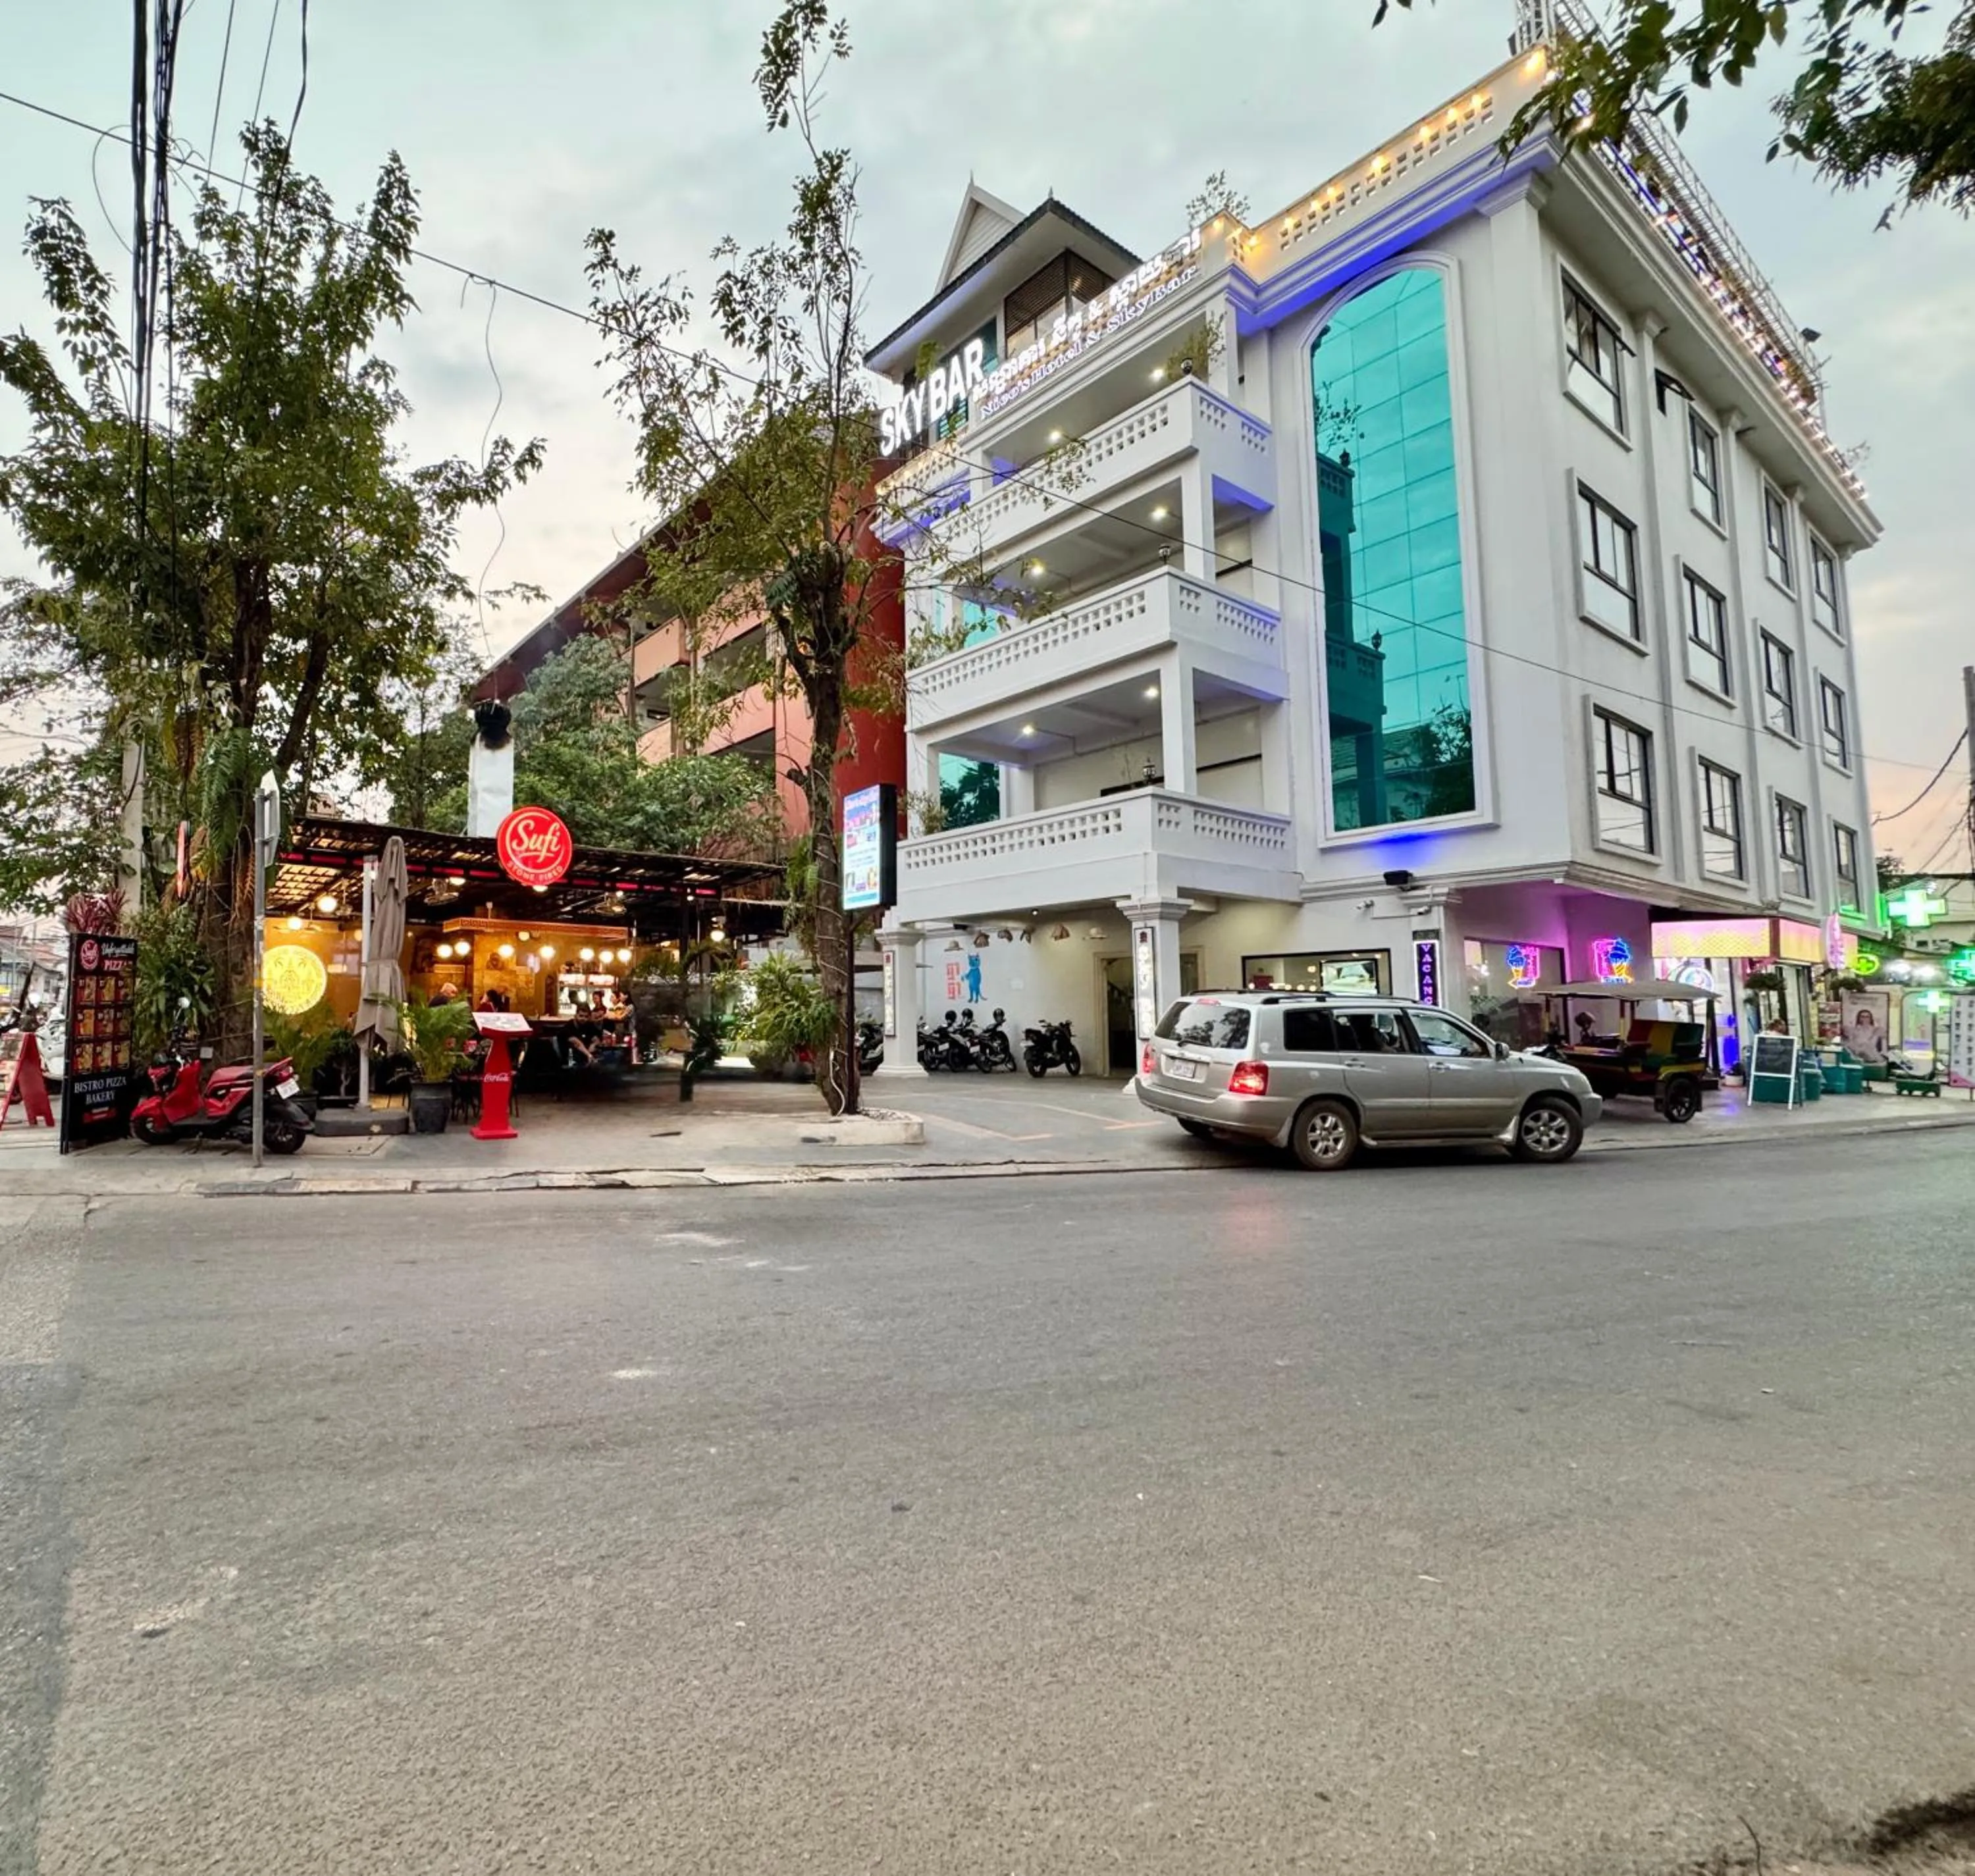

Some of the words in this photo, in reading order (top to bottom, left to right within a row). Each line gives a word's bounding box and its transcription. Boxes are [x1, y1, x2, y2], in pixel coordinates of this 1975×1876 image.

[512, 820, 561, 863] Sufi
[74, 1080, 104, 1093] BISTRO
[106, 1076, 126, 1088] PIZZA
[86, 1090, 115, 1105] BAKERY
